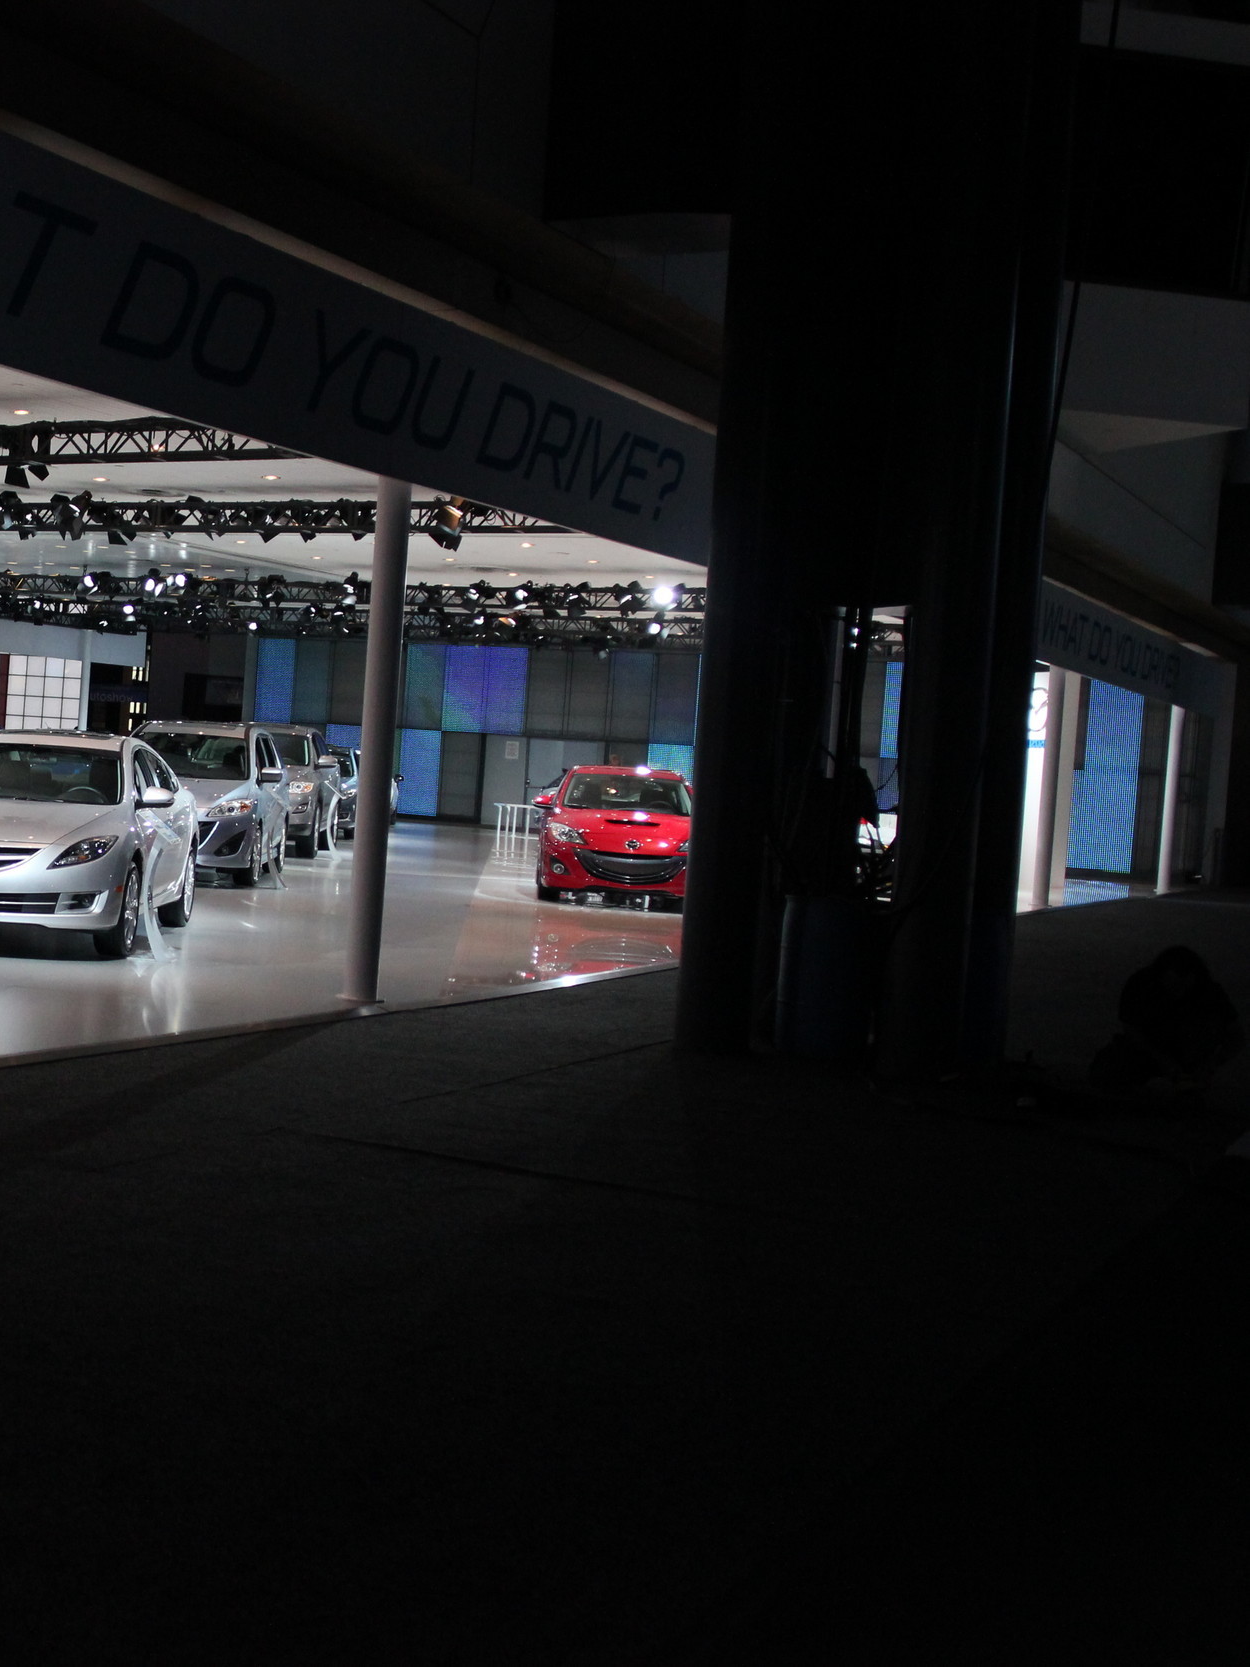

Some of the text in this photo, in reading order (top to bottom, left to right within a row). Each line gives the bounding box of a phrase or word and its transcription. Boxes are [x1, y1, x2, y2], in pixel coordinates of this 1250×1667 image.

[100, 241, 276, 388] DO
[307, 308, 475, 451] YOU
[476, 382, 686, 521] DRIVE?
[1043, 601, 1089, 655] WHAT
[1088, 621, 1111, 666] DO
